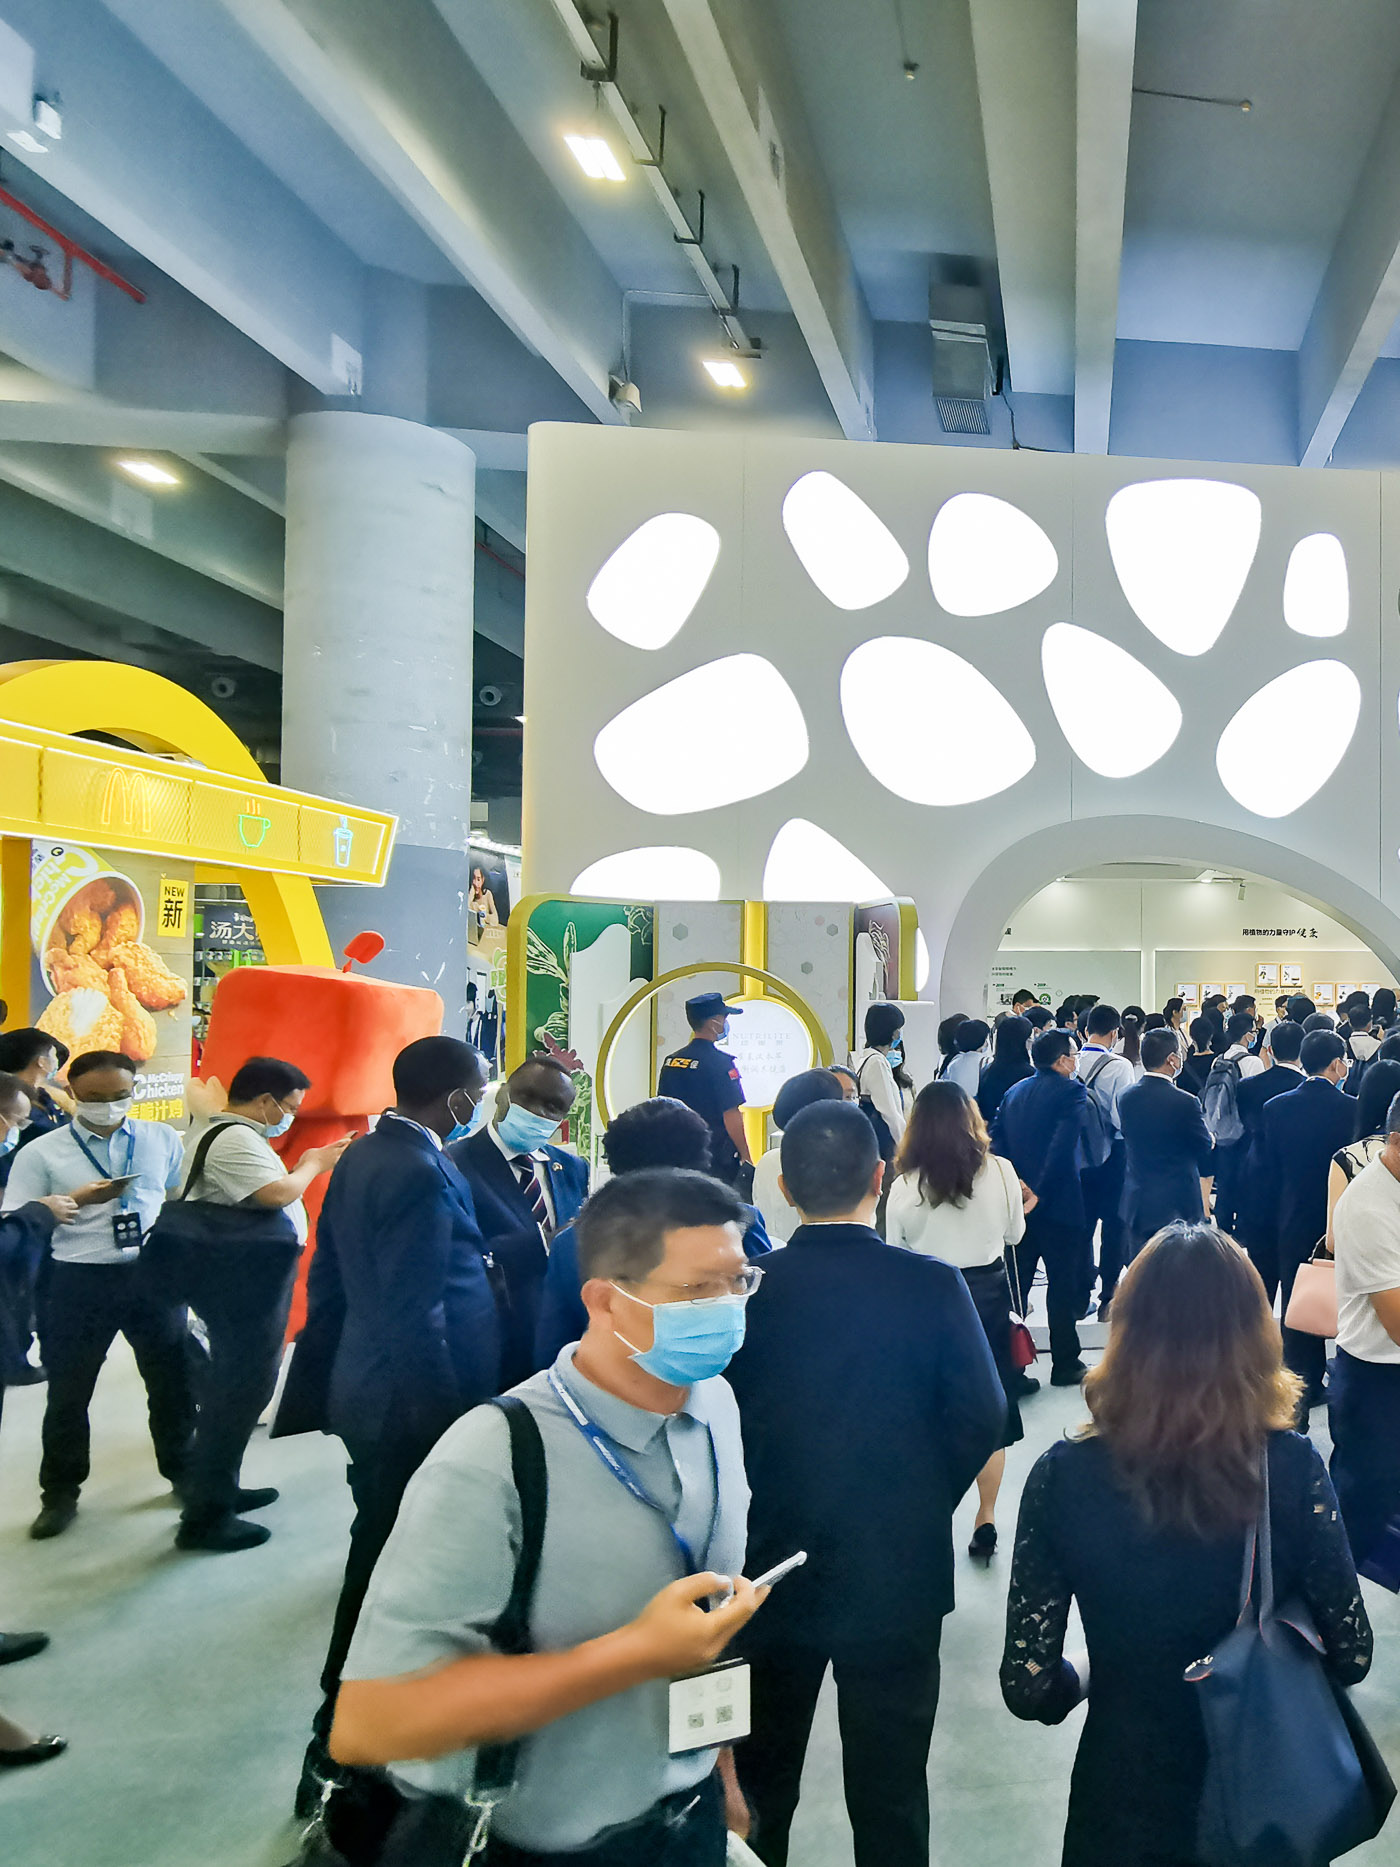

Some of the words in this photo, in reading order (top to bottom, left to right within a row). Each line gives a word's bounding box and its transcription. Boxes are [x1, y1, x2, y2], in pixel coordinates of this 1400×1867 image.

[164, 886, 185, 897] NEW
[162, 899, 184, 929] 新
[209, 920, 259, 941] 汤大
